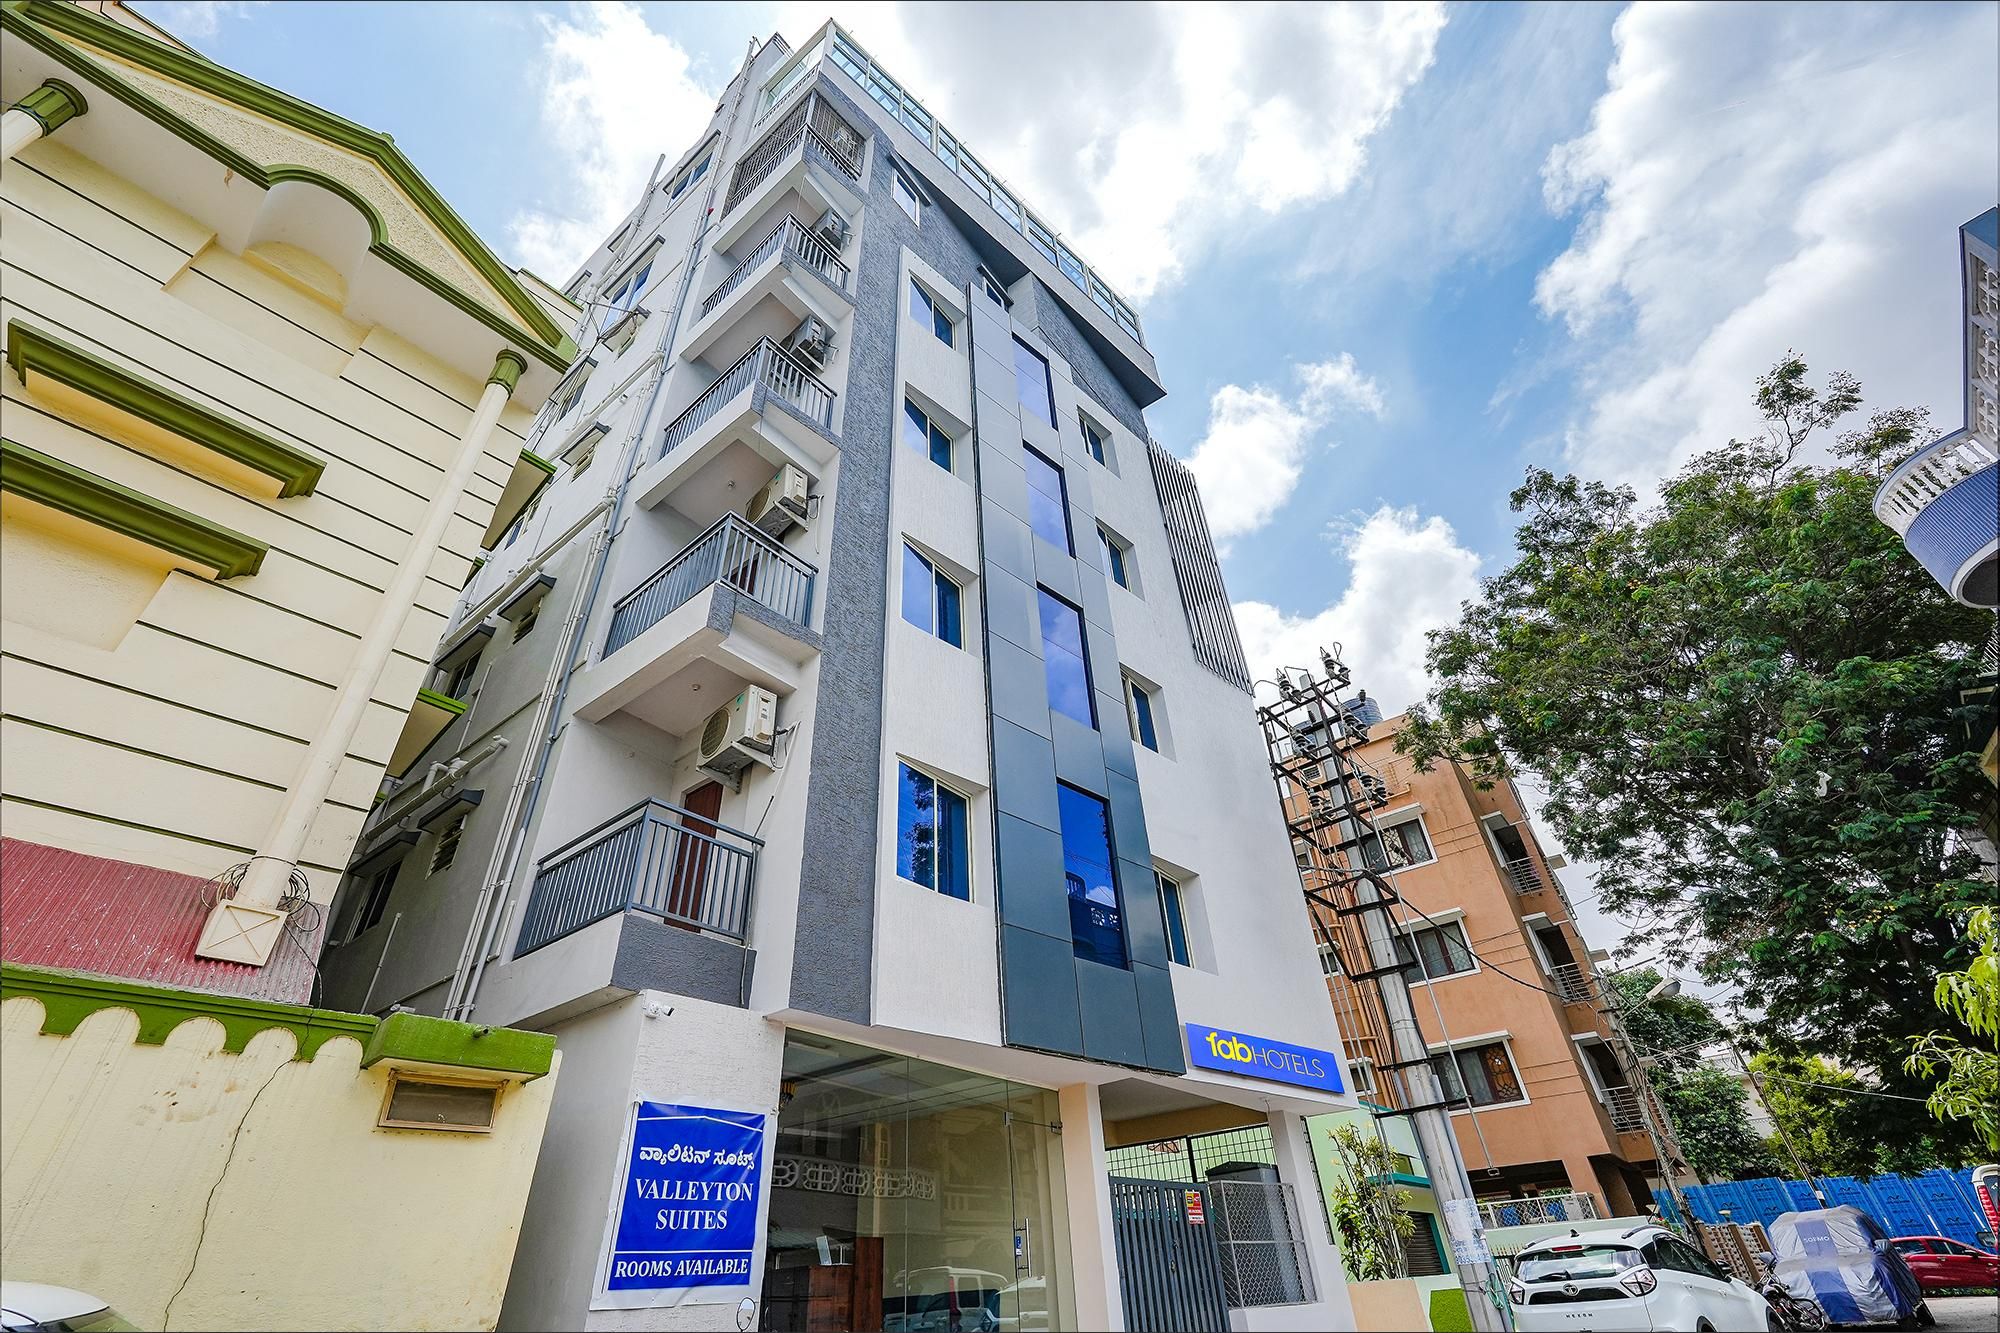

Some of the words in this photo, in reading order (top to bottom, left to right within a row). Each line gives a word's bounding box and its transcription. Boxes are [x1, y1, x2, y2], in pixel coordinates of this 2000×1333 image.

[1205, 1031, 1325, 1078] fabHOTELS
[639, 1143, 711, 1166] ವ್ಯಾಲಿಟನ್
[635, 1178, 753, 1201] VALLEYTON
[655, 1209, 728, 1230] SUITES
[614, 1260, 672, 1278] ROOMS
[674, 1258, 749, 1276] AVAILABLE
